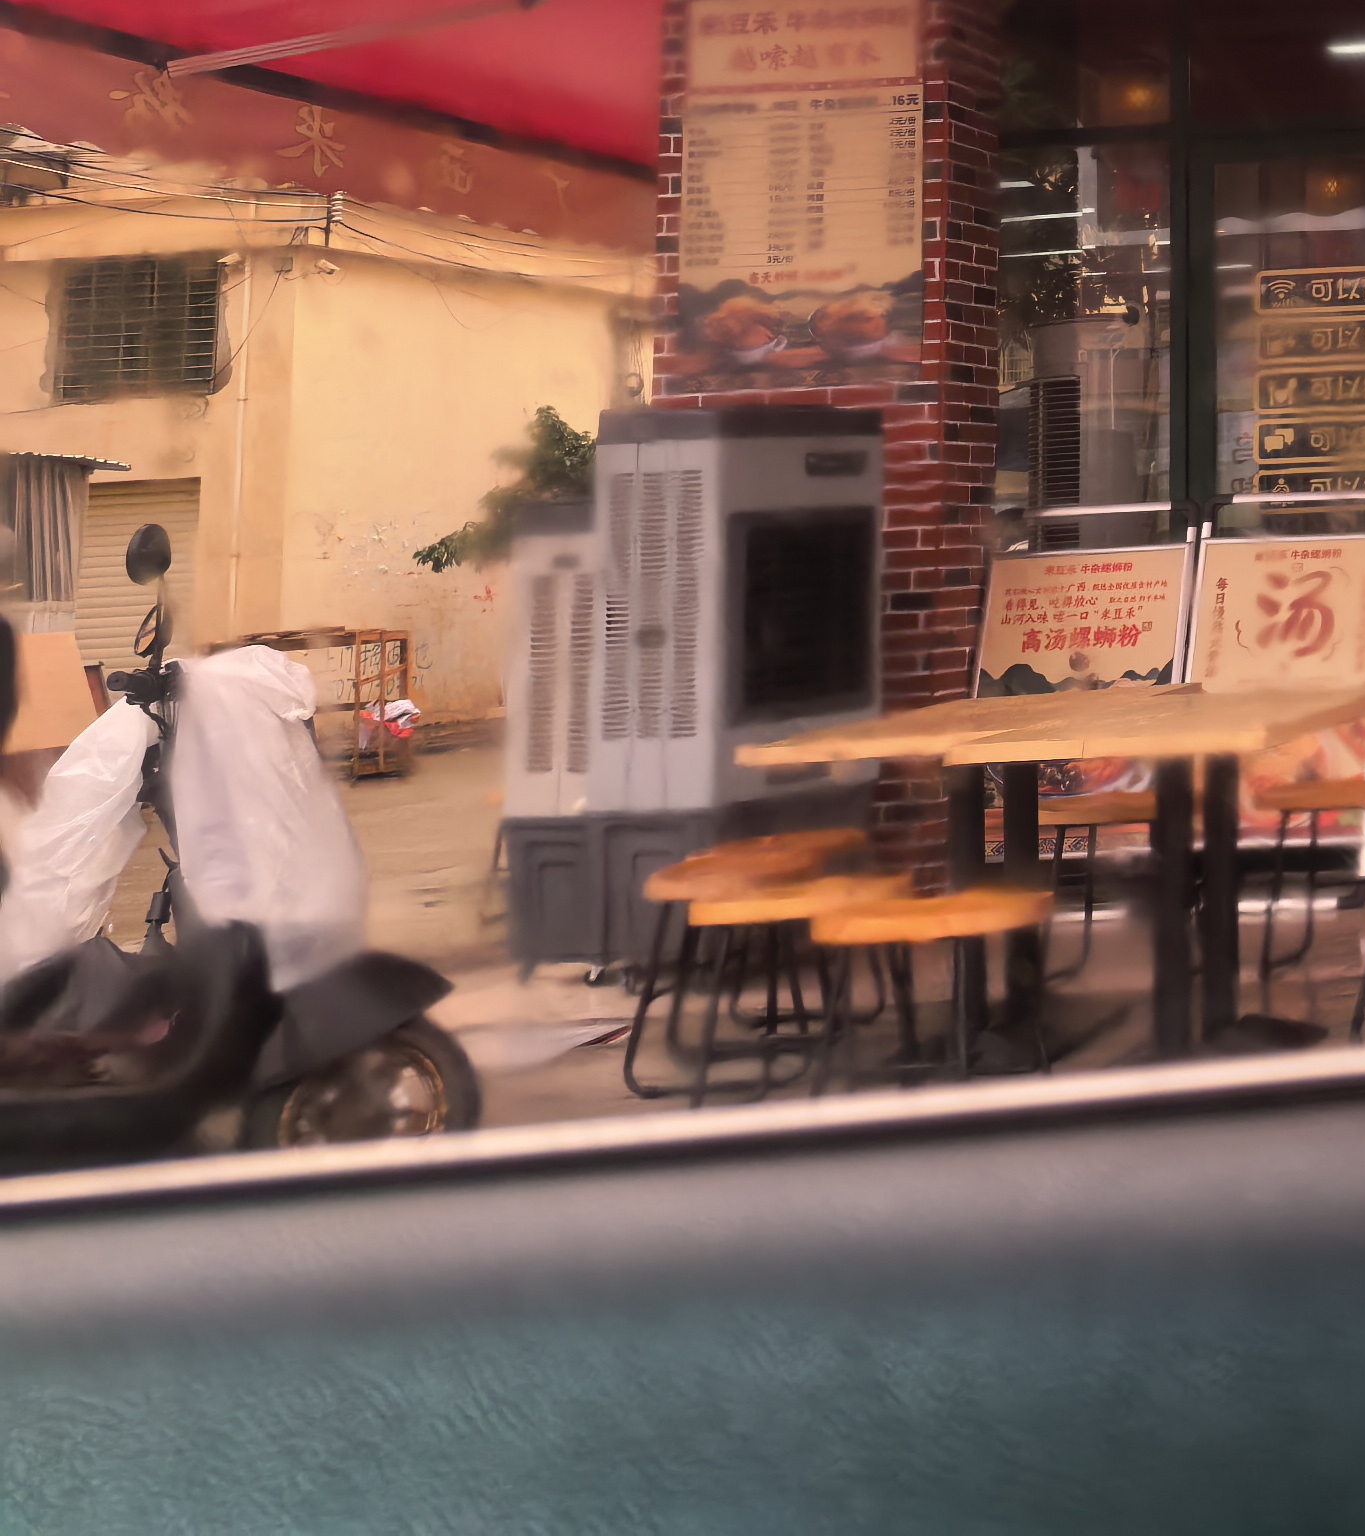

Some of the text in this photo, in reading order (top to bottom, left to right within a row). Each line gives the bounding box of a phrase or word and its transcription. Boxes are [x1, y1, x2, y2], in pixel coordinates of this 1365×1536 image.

[1021, 623, 1143, 654] 高汤螺蛳粉
[1255, 569, 1336, 658] 汤
